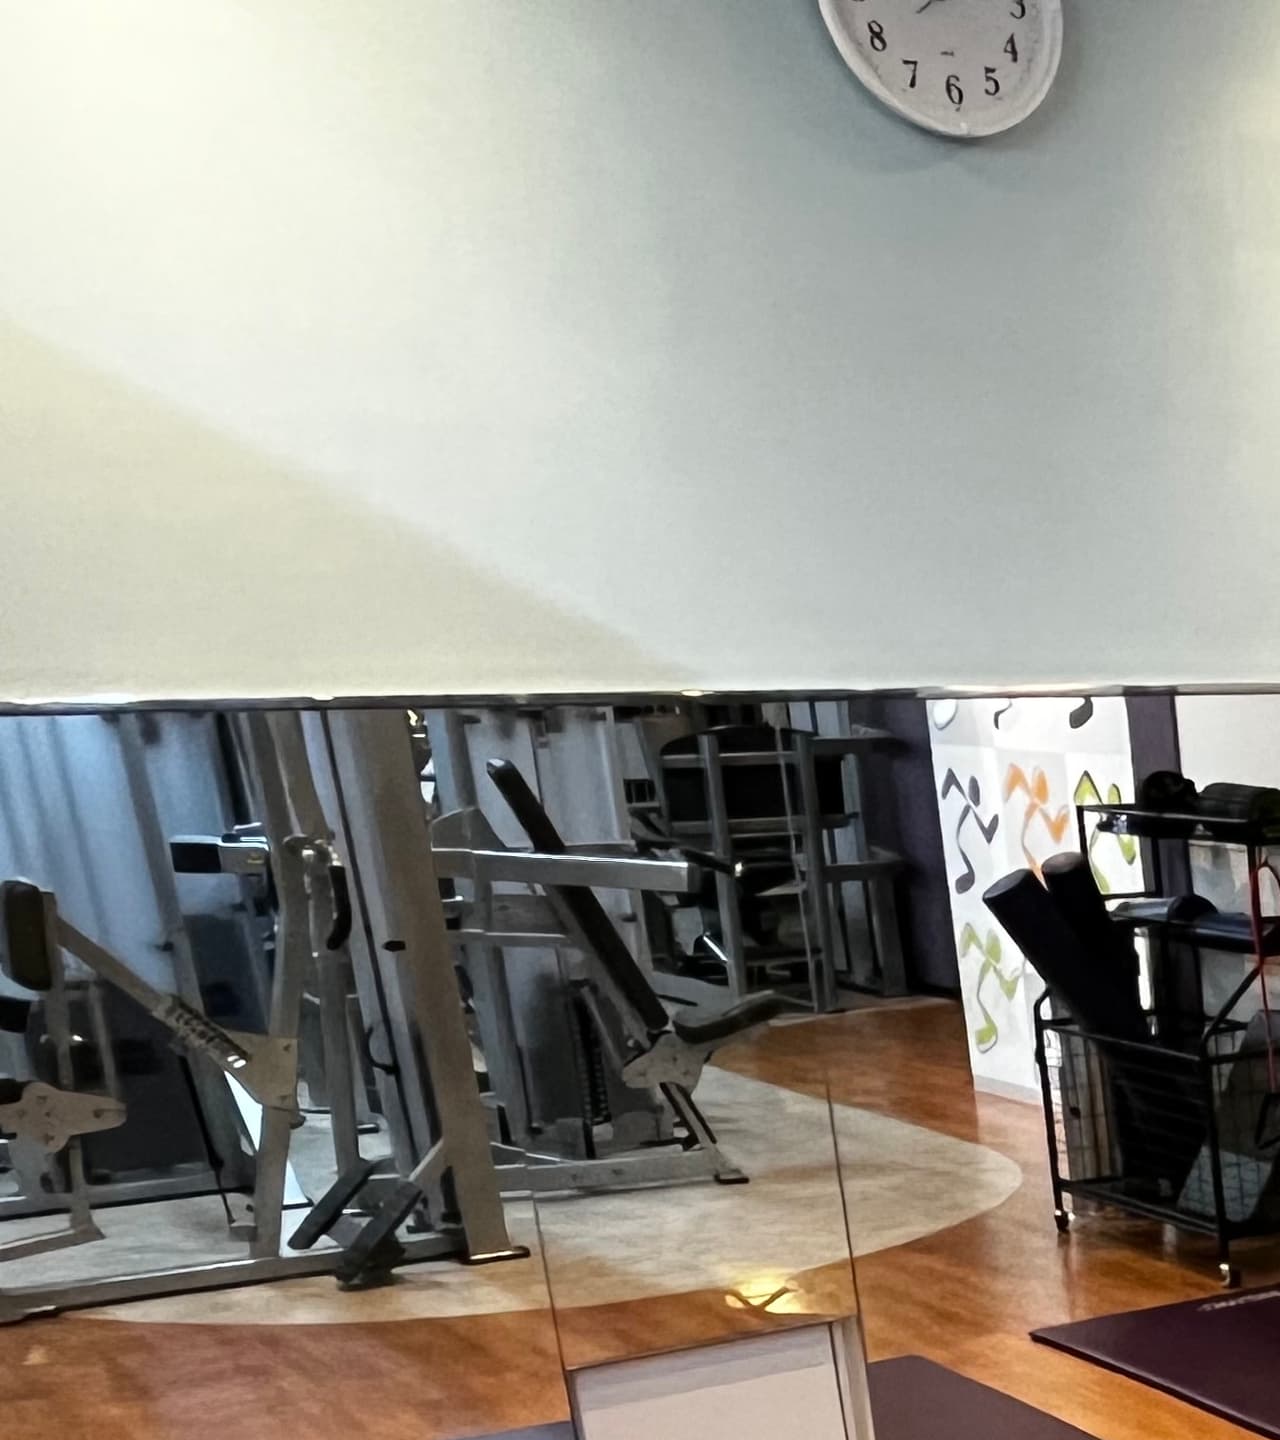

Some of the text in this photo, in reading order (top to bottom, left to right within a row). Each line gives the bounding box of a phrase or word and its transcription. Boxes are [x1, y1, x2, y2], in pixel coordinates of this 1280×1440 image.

[867, 20, 887, 51] 8
[1003, 33, 1018, 63] 4
[902, 59, 918, 88] 7
[984, 66, 1000, 96] 5
[946, 75, 964, 105] 6
